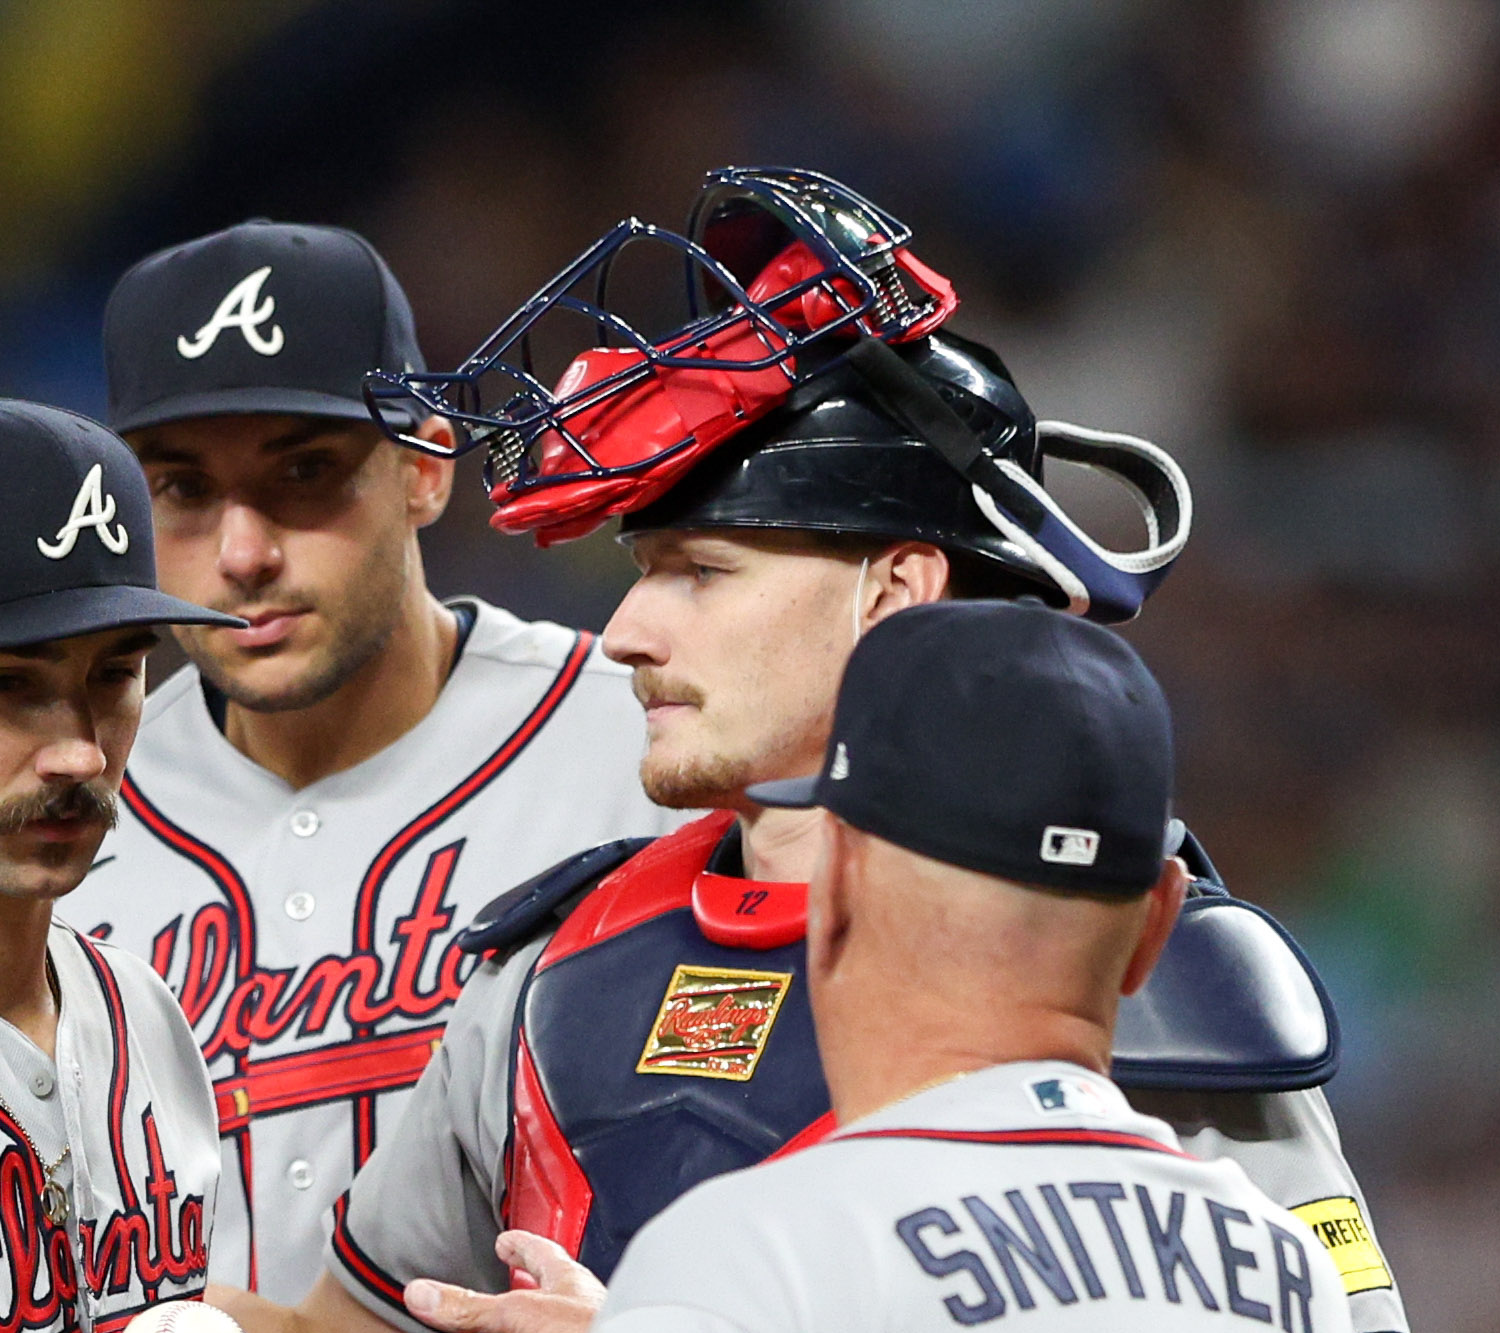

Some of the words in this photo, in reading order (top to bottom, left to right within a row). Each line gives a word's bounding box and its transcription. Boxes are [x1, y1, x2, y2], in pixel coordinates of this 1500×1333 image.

[176, 266, 285, 359] A
[36, 463, 129, 560] A
[736, 891, 769, 915] 12
[657, 994, 768, 1042] Rawlings
